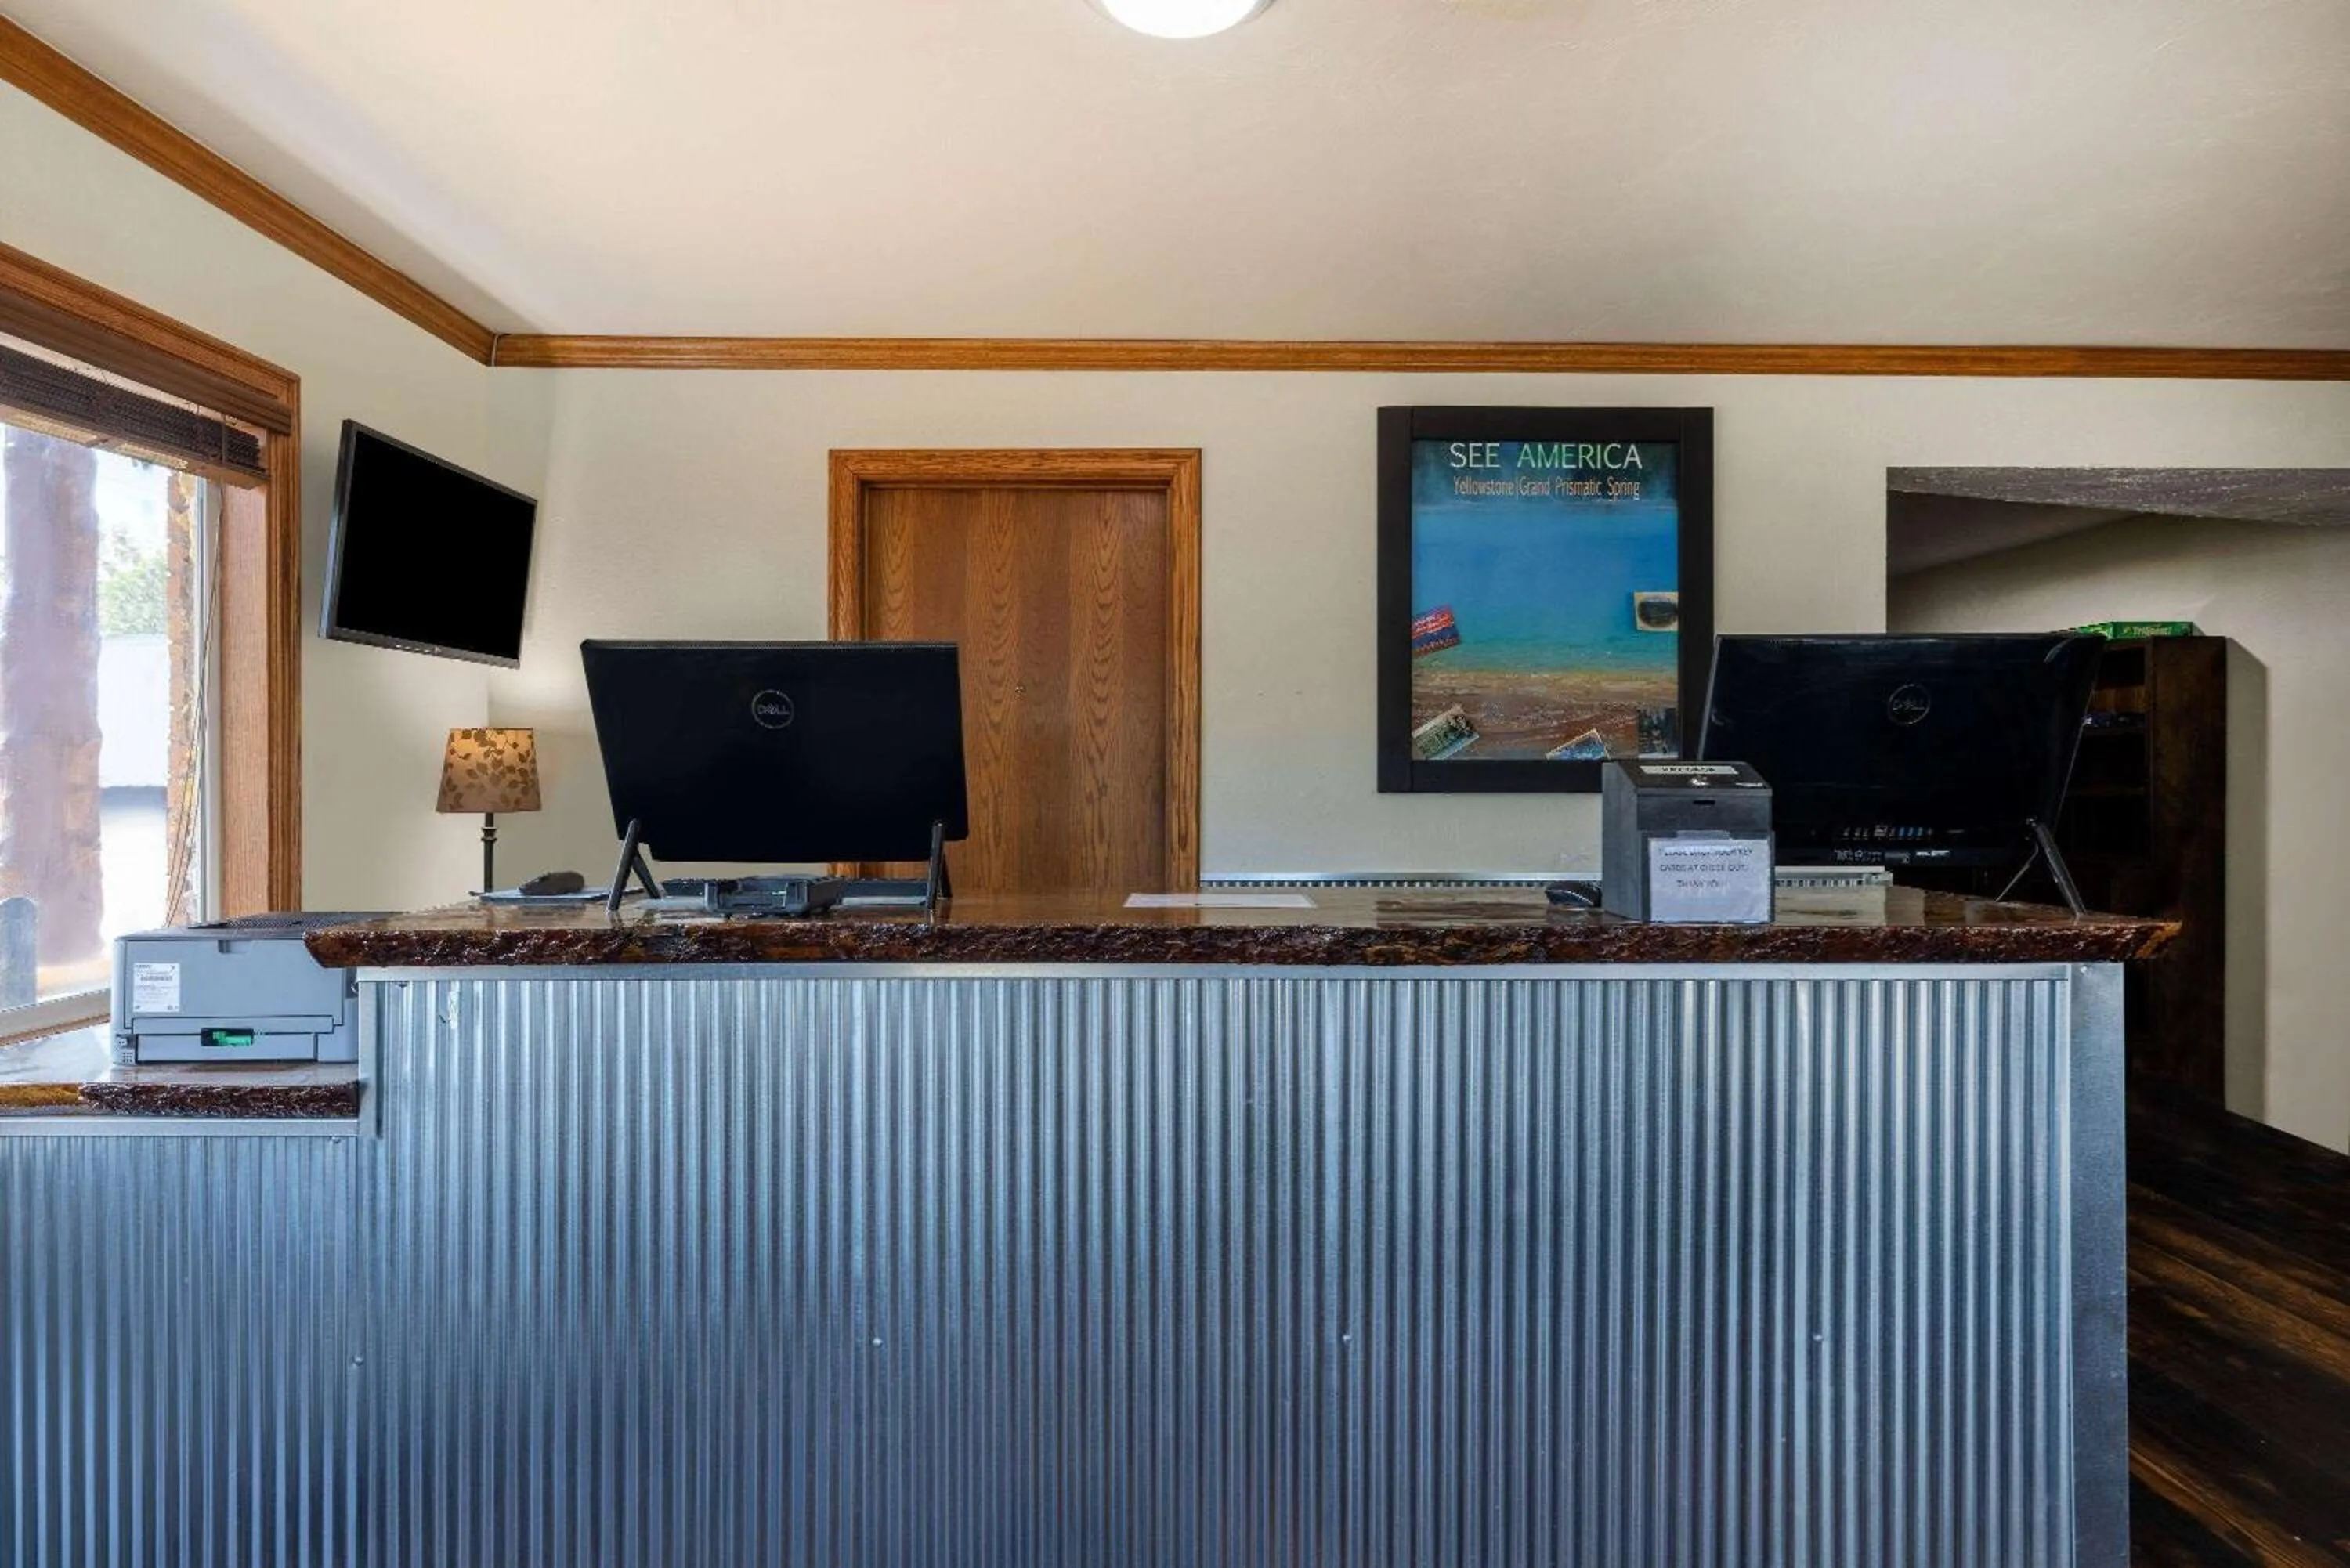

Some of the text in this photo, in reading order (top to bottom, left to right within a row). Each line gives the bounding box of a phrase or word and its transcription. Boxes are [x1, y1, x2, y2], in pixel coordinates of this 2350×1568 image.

[1450, 443, 1643, 469] SEE AMERICA
[1555, 475, 1602, 495] Prismatic
[1607, 475, 1641, 501] Spring
